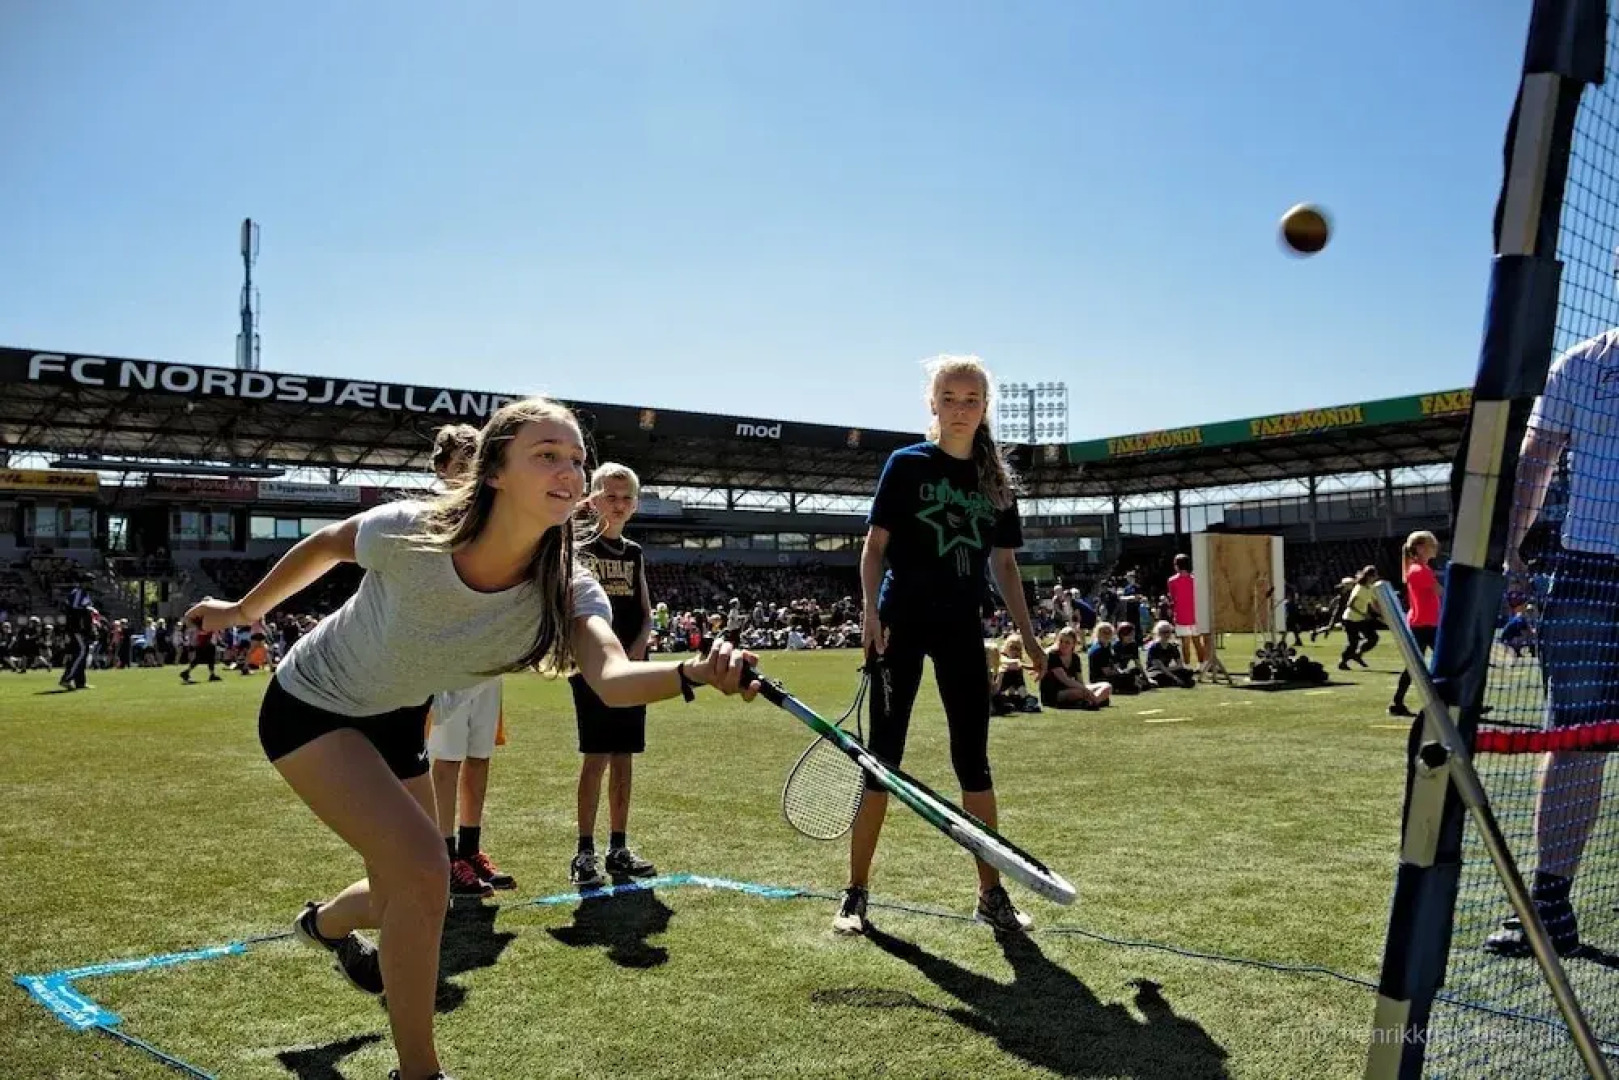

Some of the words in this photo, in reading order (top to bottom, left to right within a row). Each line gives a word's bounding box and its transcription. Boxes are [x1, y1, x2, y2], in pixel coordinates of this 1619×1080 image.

[28, 354, 108, 385] FC
[1296, 406, 1363, 431] KONDI
[736, 423, 783, 440] mod
